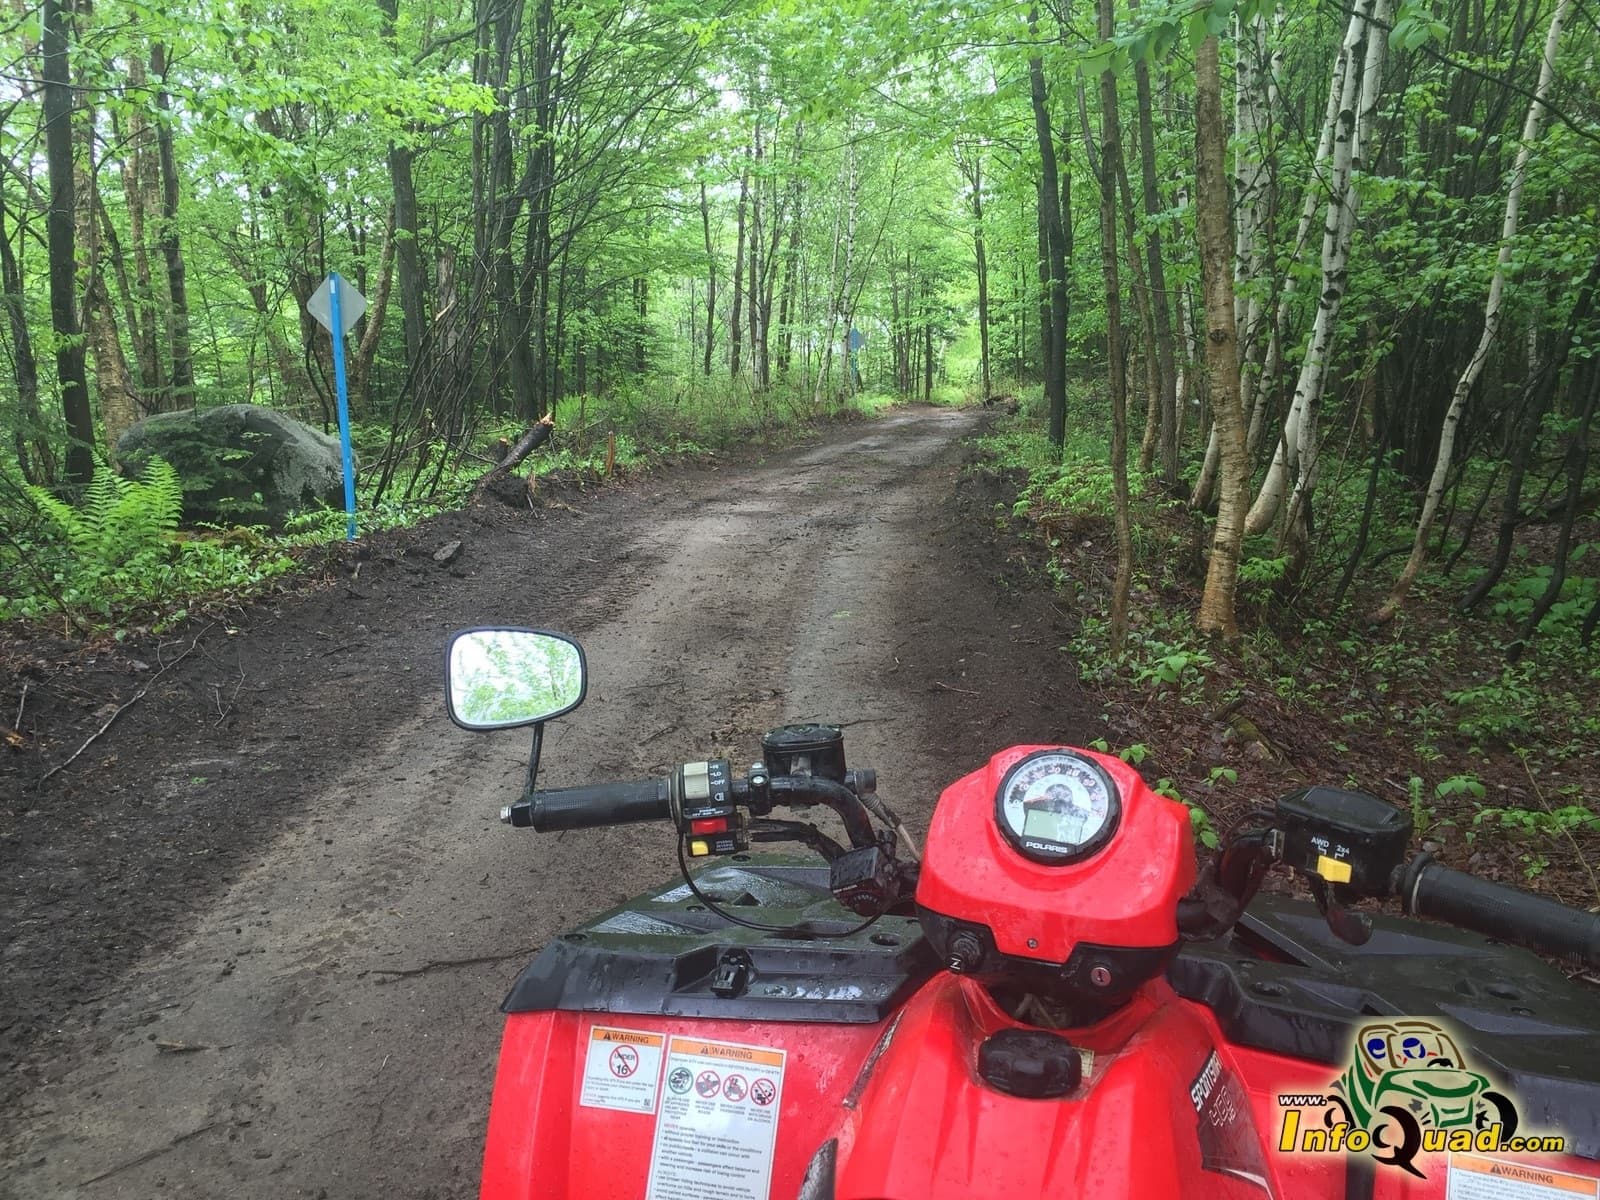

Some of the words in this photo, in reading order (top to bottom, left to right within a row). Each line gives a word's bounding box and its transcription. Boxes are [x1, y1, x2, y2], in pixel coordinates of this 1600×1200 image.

[1026, 841, 1068, 854] POLARIS
[1310, 836, 1330, 848] AWD
[612, 1033, 649, 1044] WARNING
[712, 1046, 753, 1060] WARNING
[616, 1064, 628, 1075] 16
[1502, 1166, 1553, 1184] WARNING
